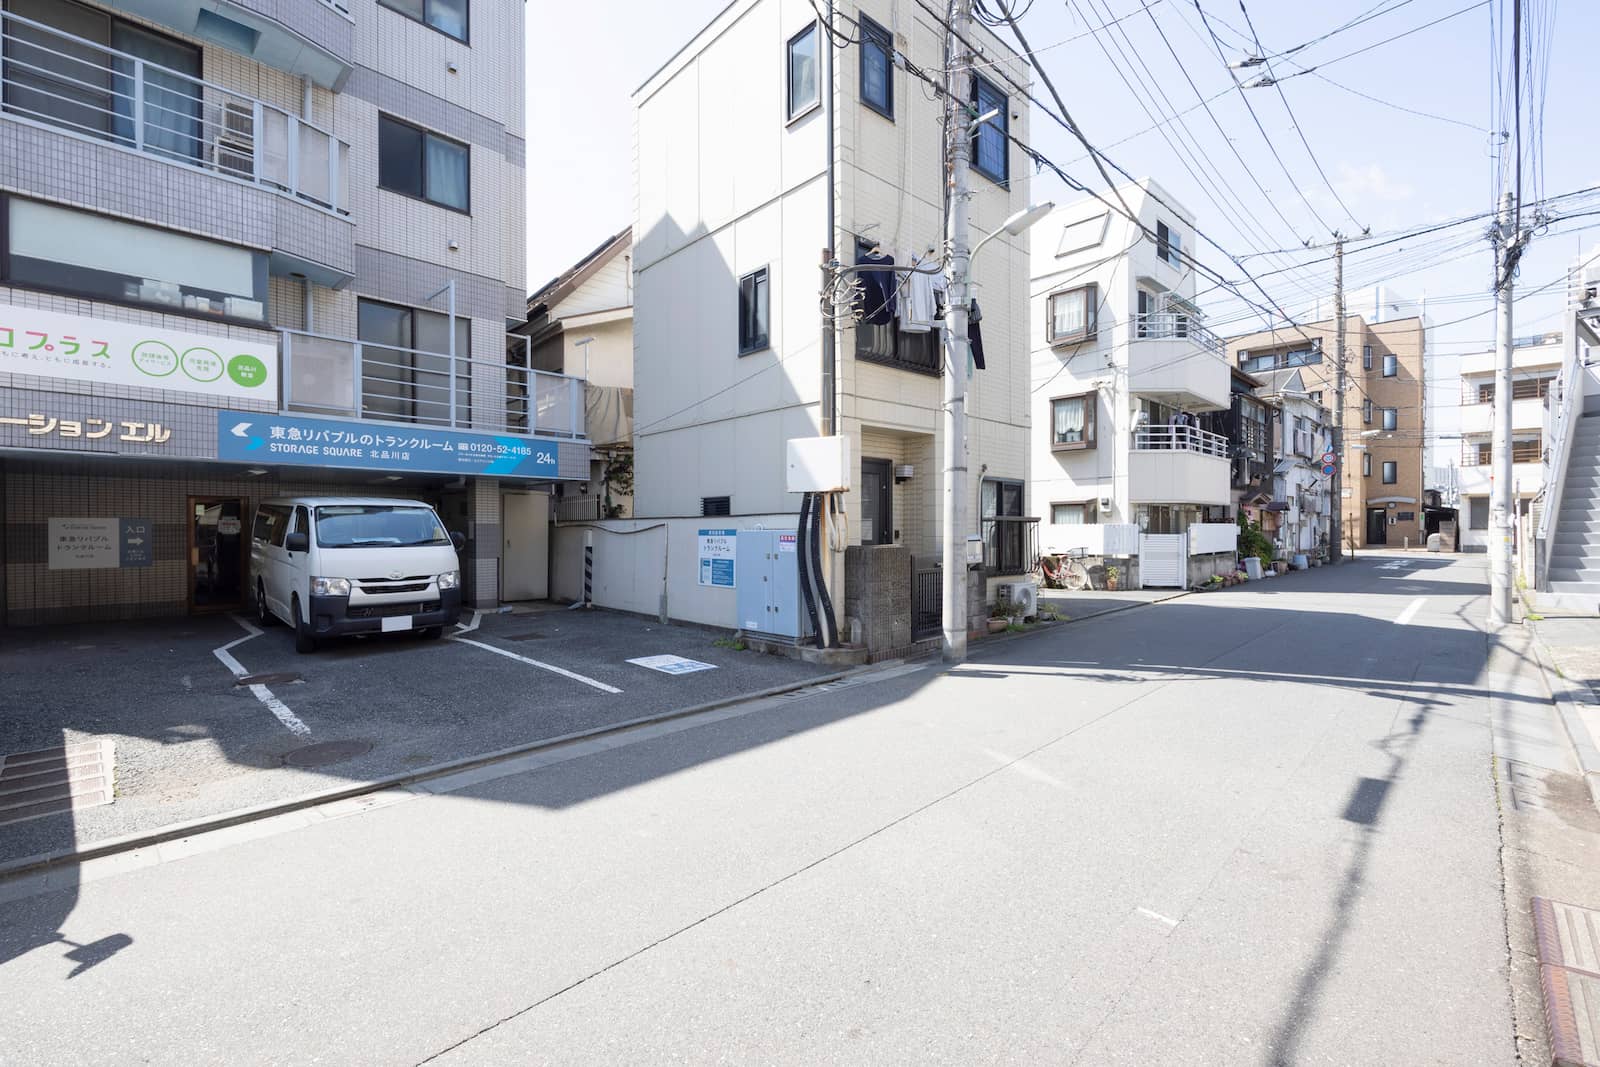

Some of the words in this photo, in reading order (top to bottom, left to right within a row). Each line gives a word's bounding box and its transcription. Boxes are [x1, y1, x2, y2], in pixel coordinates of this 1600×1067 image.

[119, 421, 172, 443] エル
[269, 425, 453, 451] 東急リバブルのトランクルーム
[270, 443, 319, 455] STORAGE
[323, 445, 363, 458] SQUARE
[370, 450, 410, 460] 北品川店
[537, 452, 556, 465] 24h
[126, 525, 145, 533] 入口
